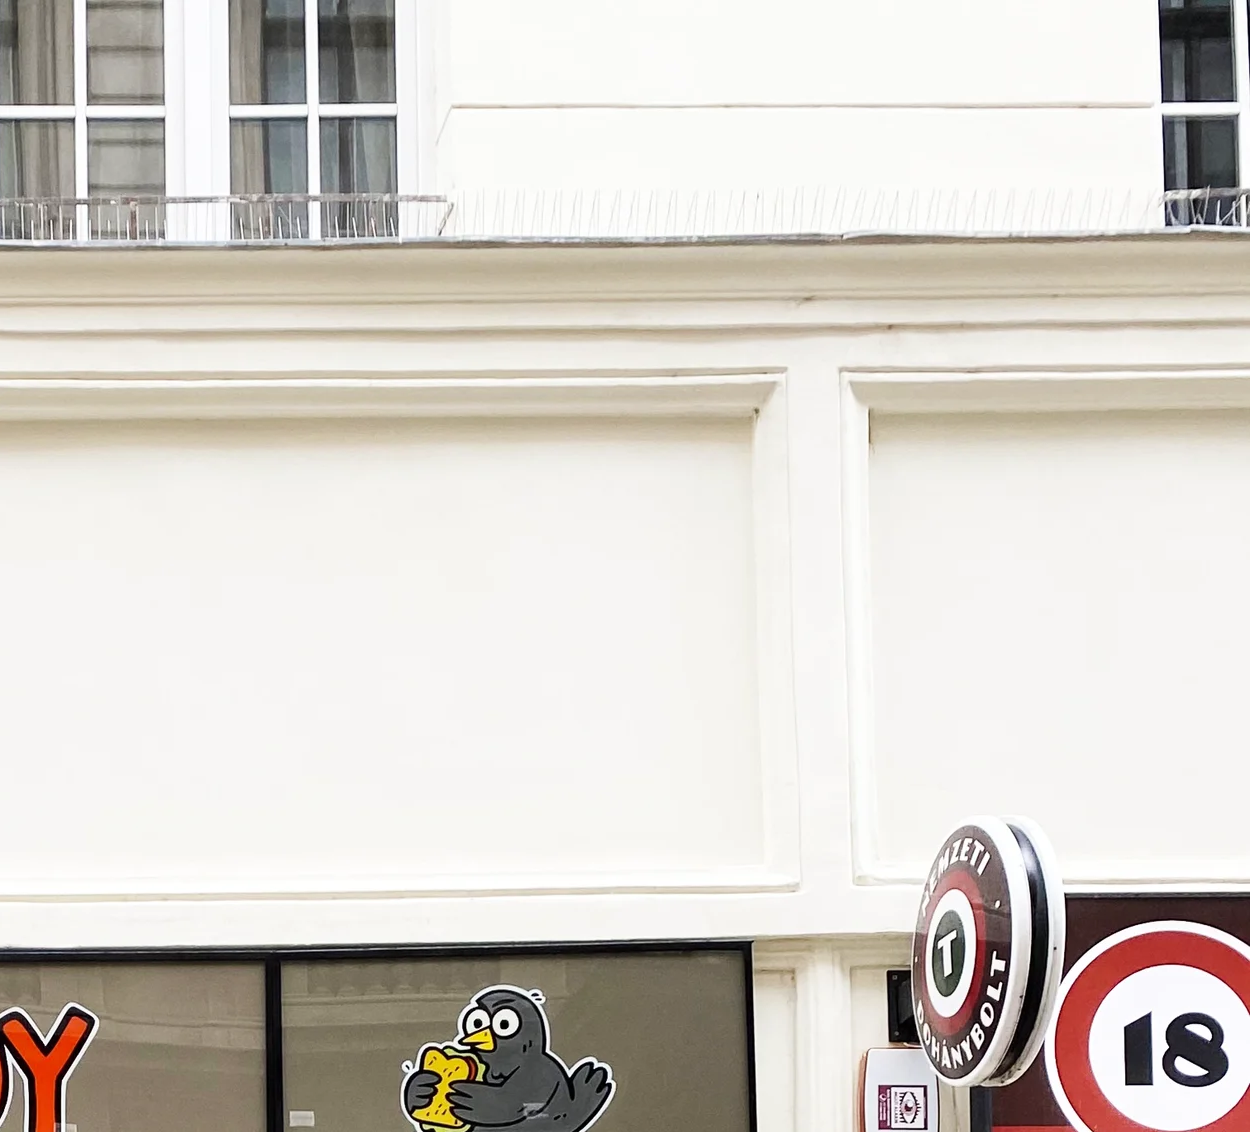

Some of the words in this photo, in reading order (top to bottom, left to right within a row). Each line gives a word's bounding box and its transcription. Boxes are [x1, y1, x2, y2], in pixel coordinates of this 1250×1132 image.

[921, 836, 991, 917] NEMZETI
[937, 930, 957, 978] T
[916, 950, 1006, 1070] DOHÁNYBOLT
[1124, 1011, 1229, 1087] 18
